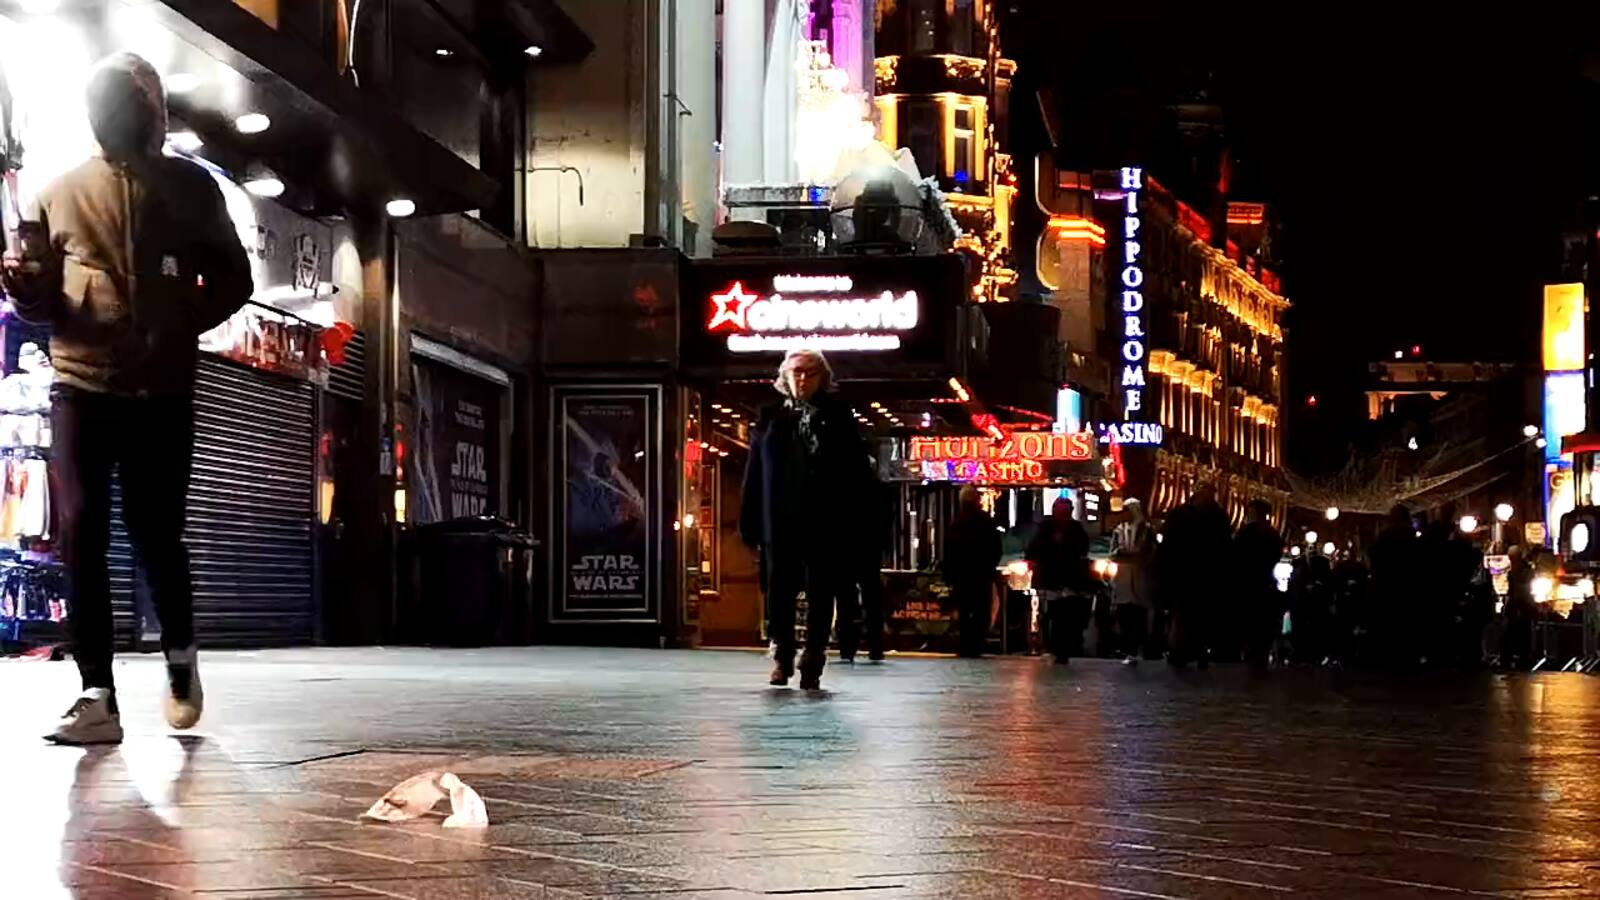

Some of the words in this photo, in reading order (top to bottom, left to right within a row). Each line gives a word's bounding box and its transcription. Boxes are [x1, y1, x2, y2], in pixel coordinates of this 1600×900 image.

[1120, 166, 1146, 412] HIPPODROME
[451, 441, 487, 482] STAR
[572, 554, 639, 571] STAR
[572, 575, 639, 591] WARS
